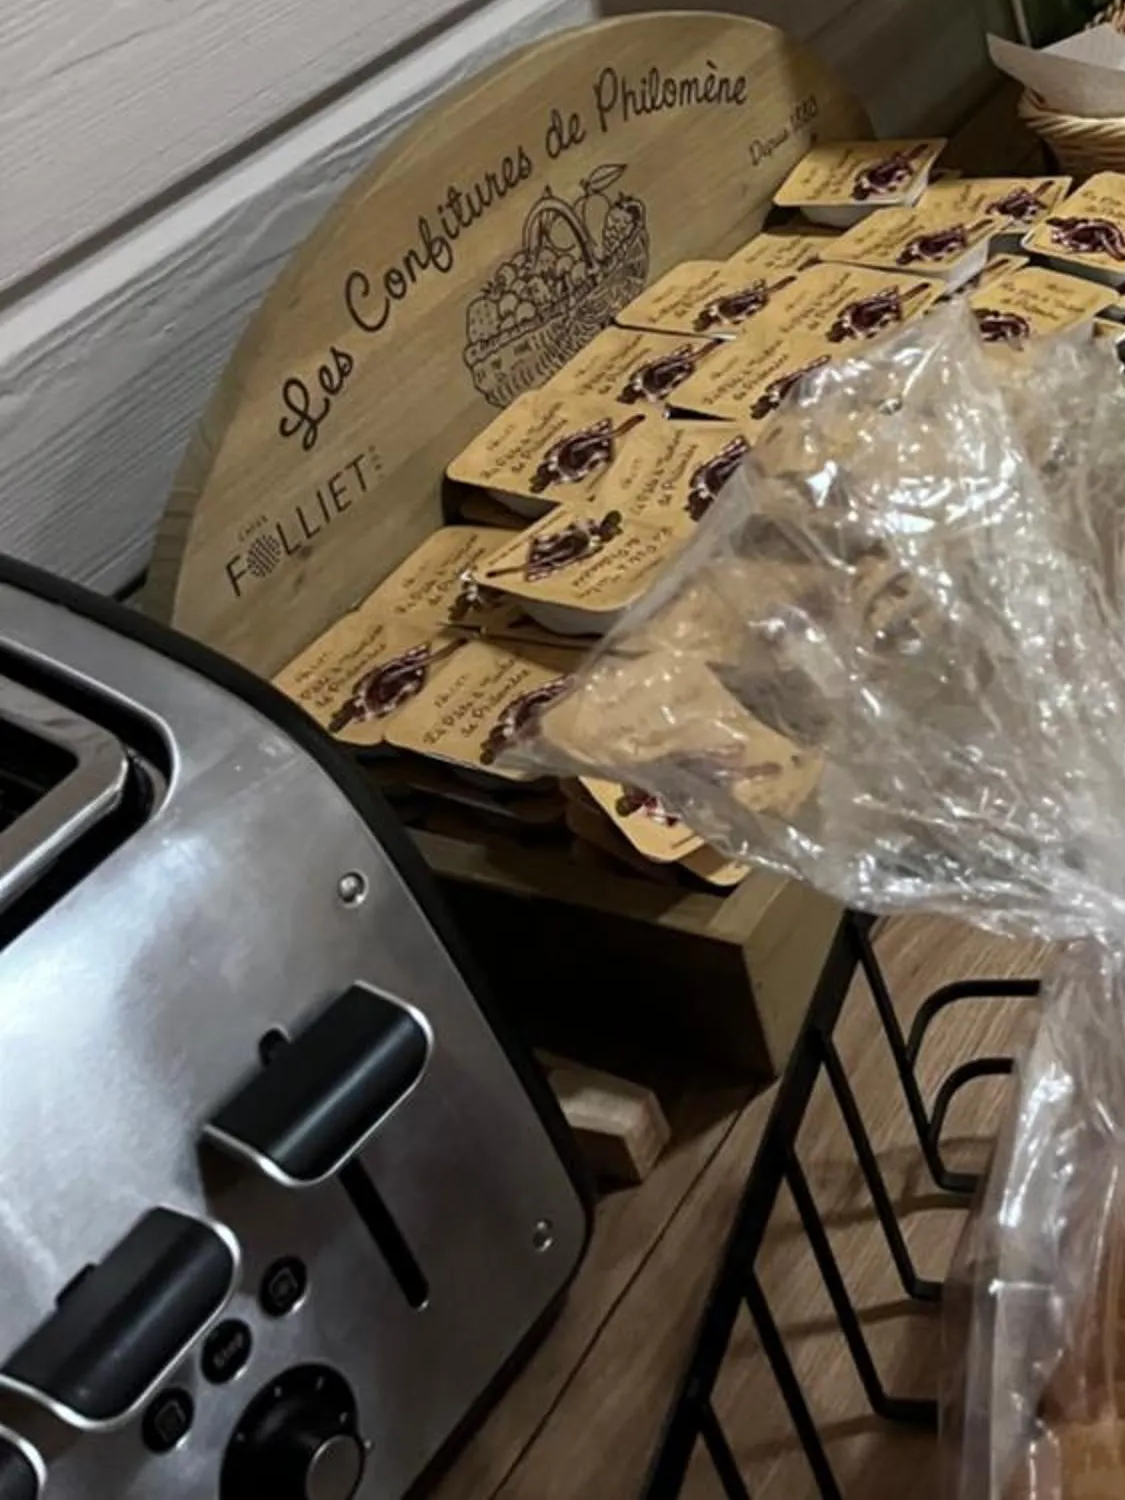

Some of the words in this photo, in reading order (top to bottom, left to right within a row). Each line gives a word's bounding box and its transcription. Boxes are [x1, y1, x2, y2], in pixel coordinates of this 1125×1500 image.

[278, 347, 355, 450] Les
[345, 144, 533, 333] Confitures
[546, 109, 586, 159] de
[593, 60, 748, 133] Philomène
